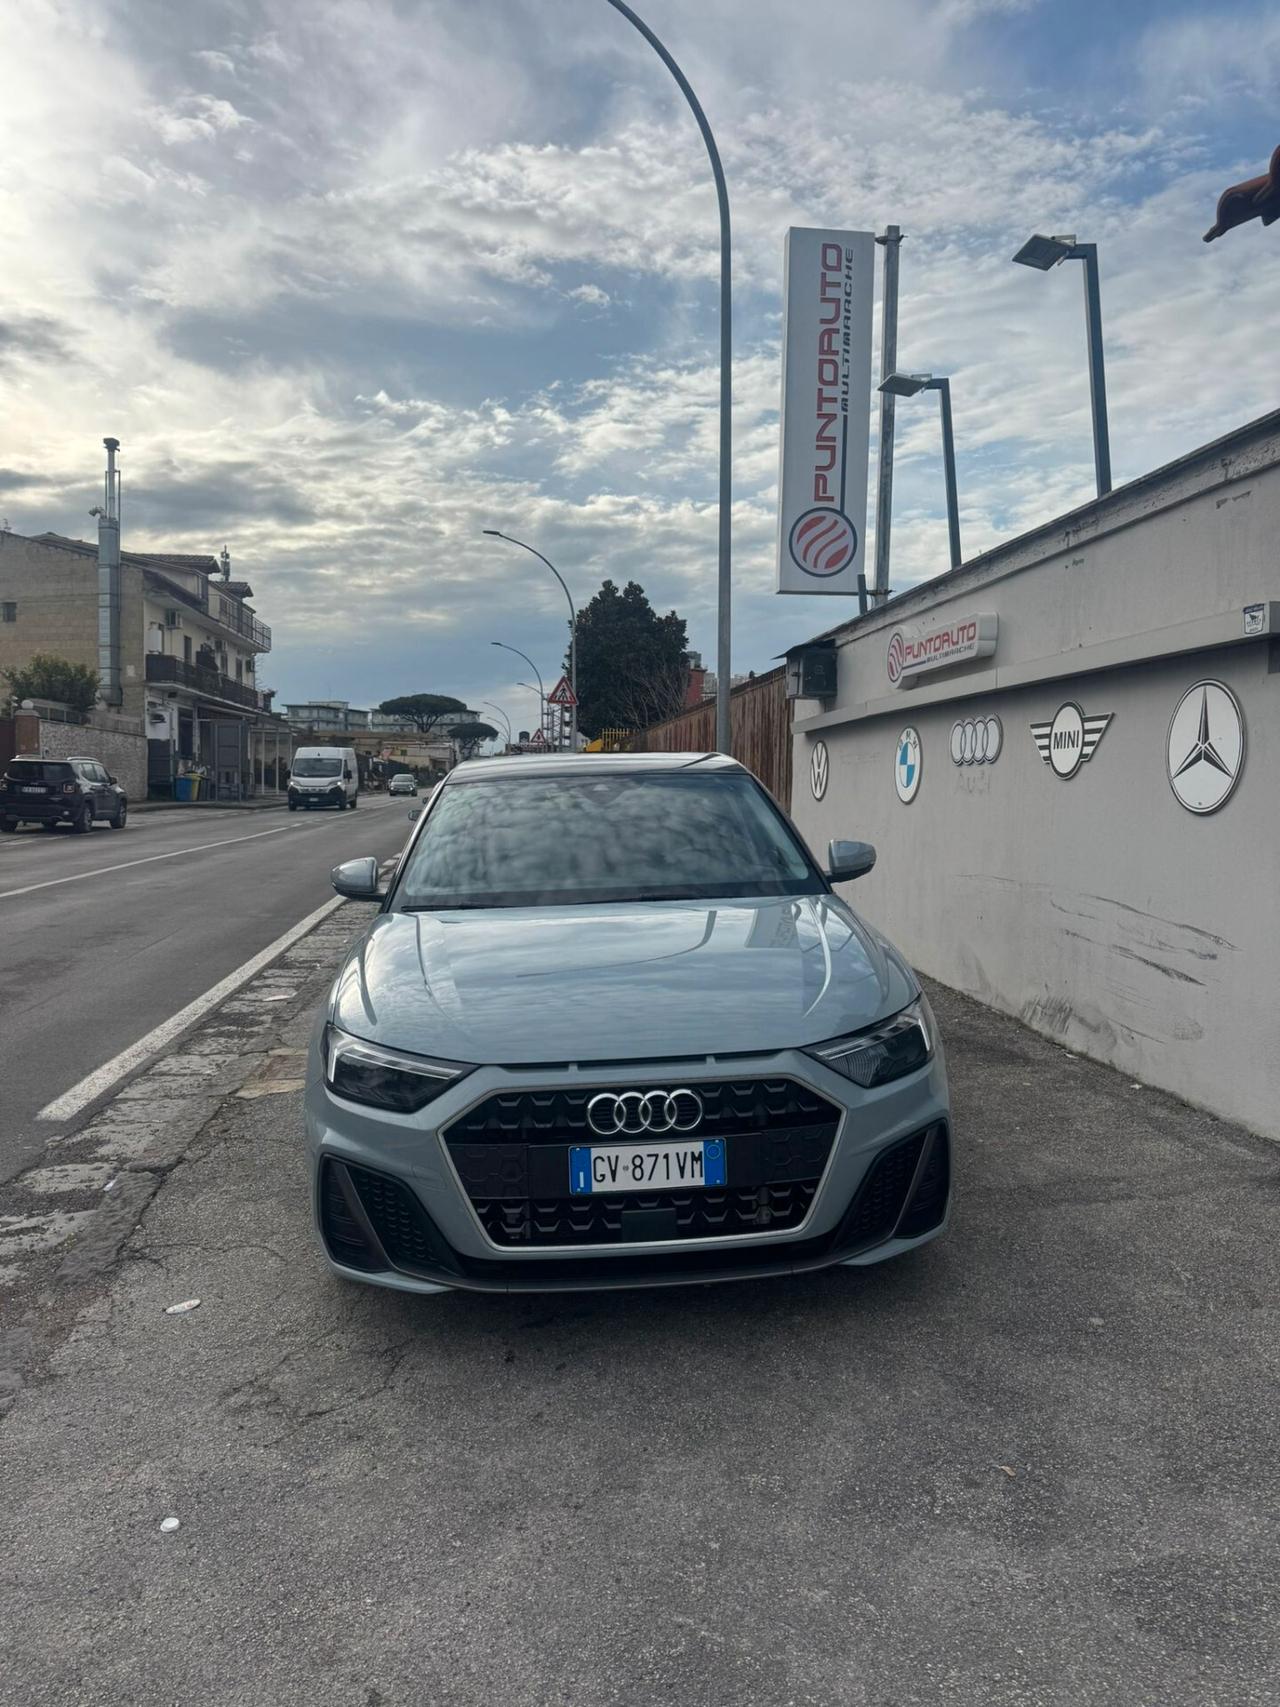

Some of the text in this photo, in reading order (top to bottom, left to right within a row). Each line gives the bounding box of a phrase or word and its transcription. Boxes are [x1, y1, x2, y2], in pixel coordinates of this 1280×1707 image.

[841, 247, 854, 413] MULTIMARCHE
[814, 243, 843, 503] PUNTOAUTO
[905, 622, 977, 663] PUNTOAUTO
[926, 643, 975, 663] MULTIMARCHE
[1053, 730, 1080, 750] MINI
[593, 1151, 704, 1183] GV 871VM
